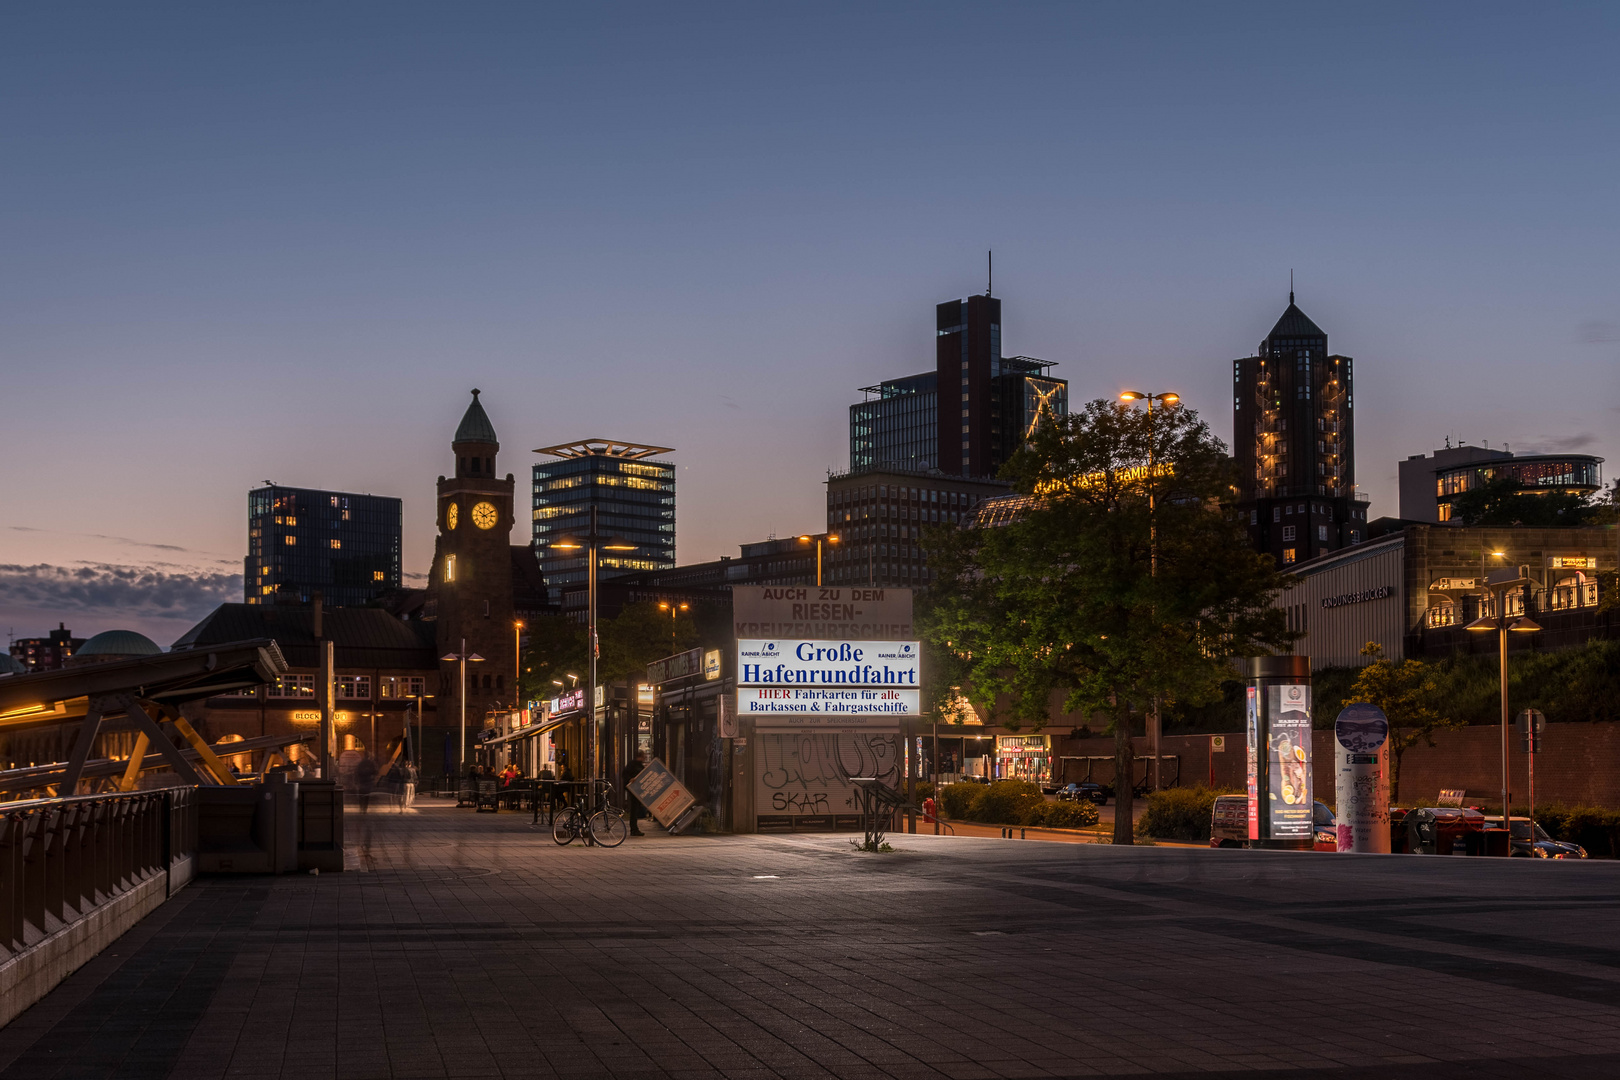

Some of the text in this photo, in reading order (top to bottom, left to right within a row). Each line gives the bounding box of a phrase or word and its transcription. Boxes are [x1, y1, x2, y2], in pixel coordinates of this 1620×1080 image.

[763, 589, 885, 601] AUCH ZU DEM
[792, 603, 863, 621] RIESEN-
[795, 642, 864, 662] Große
[742, 664, 916, 684] Hafenrundfahrt
[758, 689, 900, 700] HIER Fahrkarten für alle
[749, 701, 807, 712] Barkassen
[810, 702, 820, 712] &
[824, 701, 908, 714] Fahrgastschiffe
[772, 792, 832, 815] SKAR
